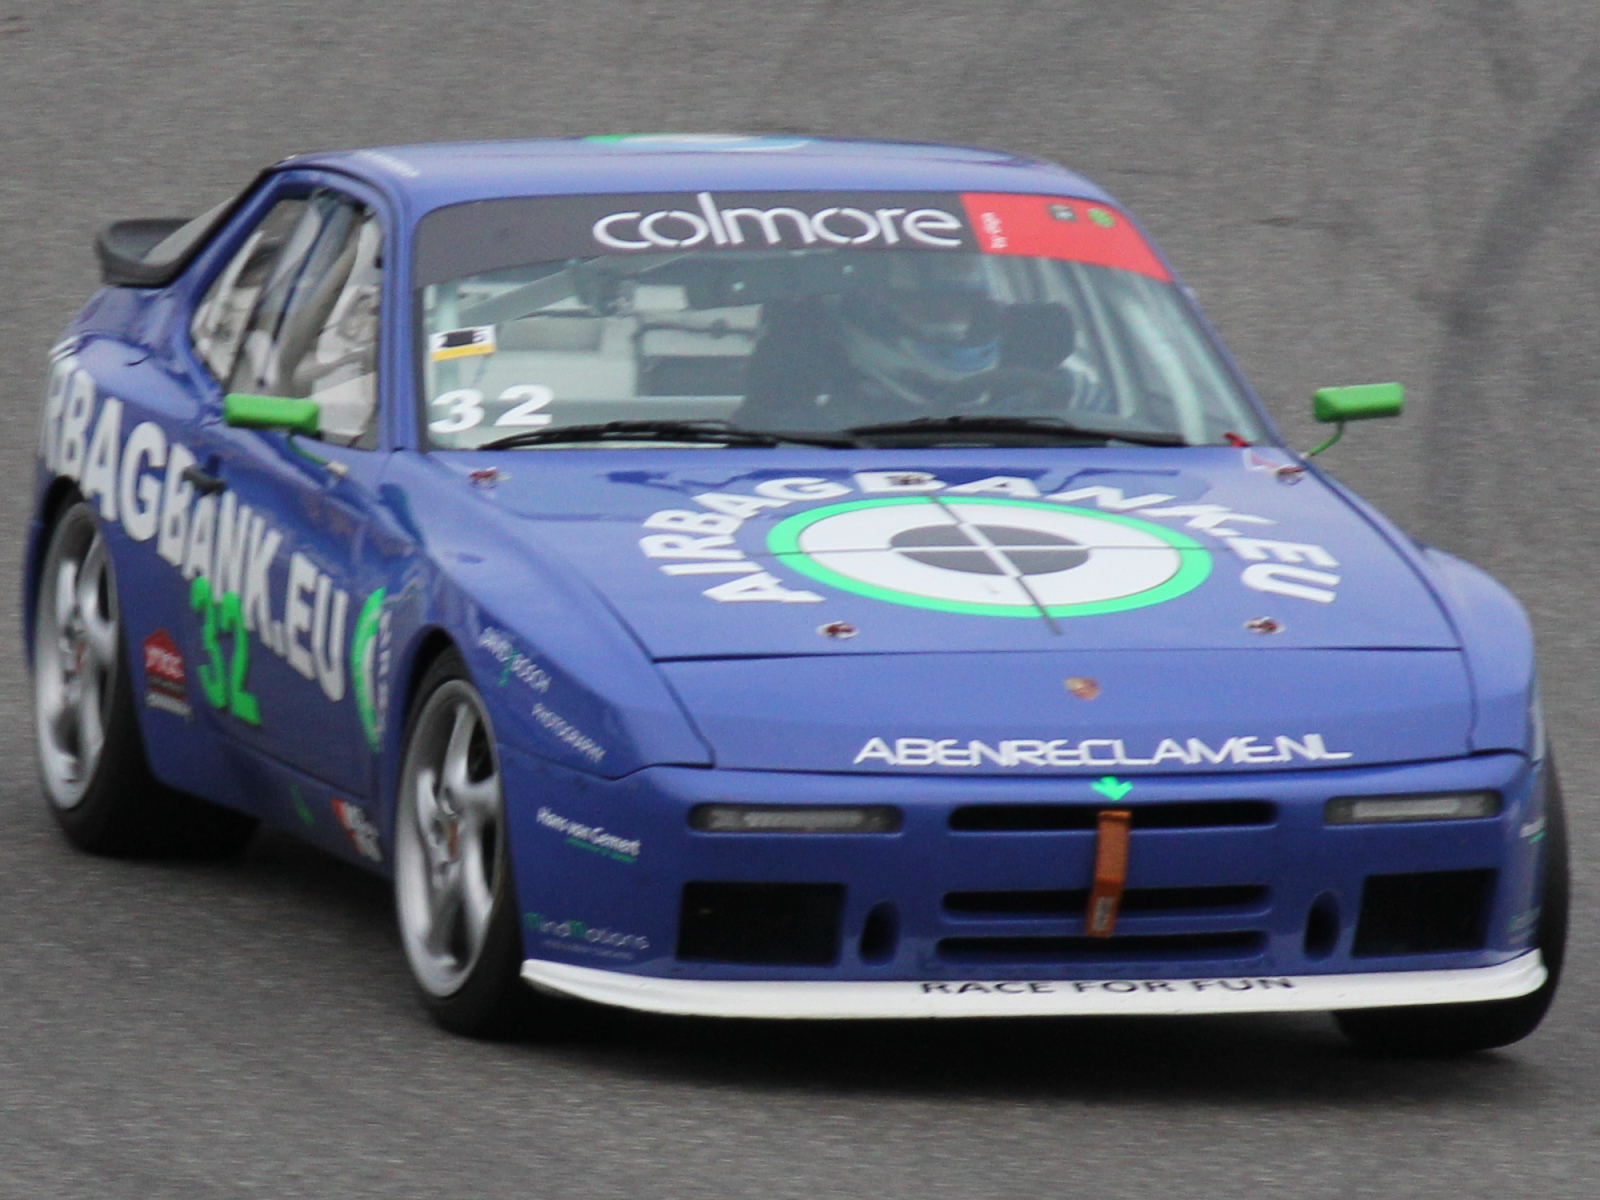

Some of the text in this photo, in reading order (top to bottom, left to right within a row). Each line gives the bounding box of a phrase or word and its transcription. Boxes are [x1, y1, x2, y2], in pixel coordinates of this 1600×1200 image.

[593, 192, 963, 250] colmore
[428, 384, 554, 433] 32
[638, 470, 1341, 604] AIRBAGBANK.EU
[189, 575, 261, 725] 32
[920, 976, 1297, 995] RACE FOR FUN
